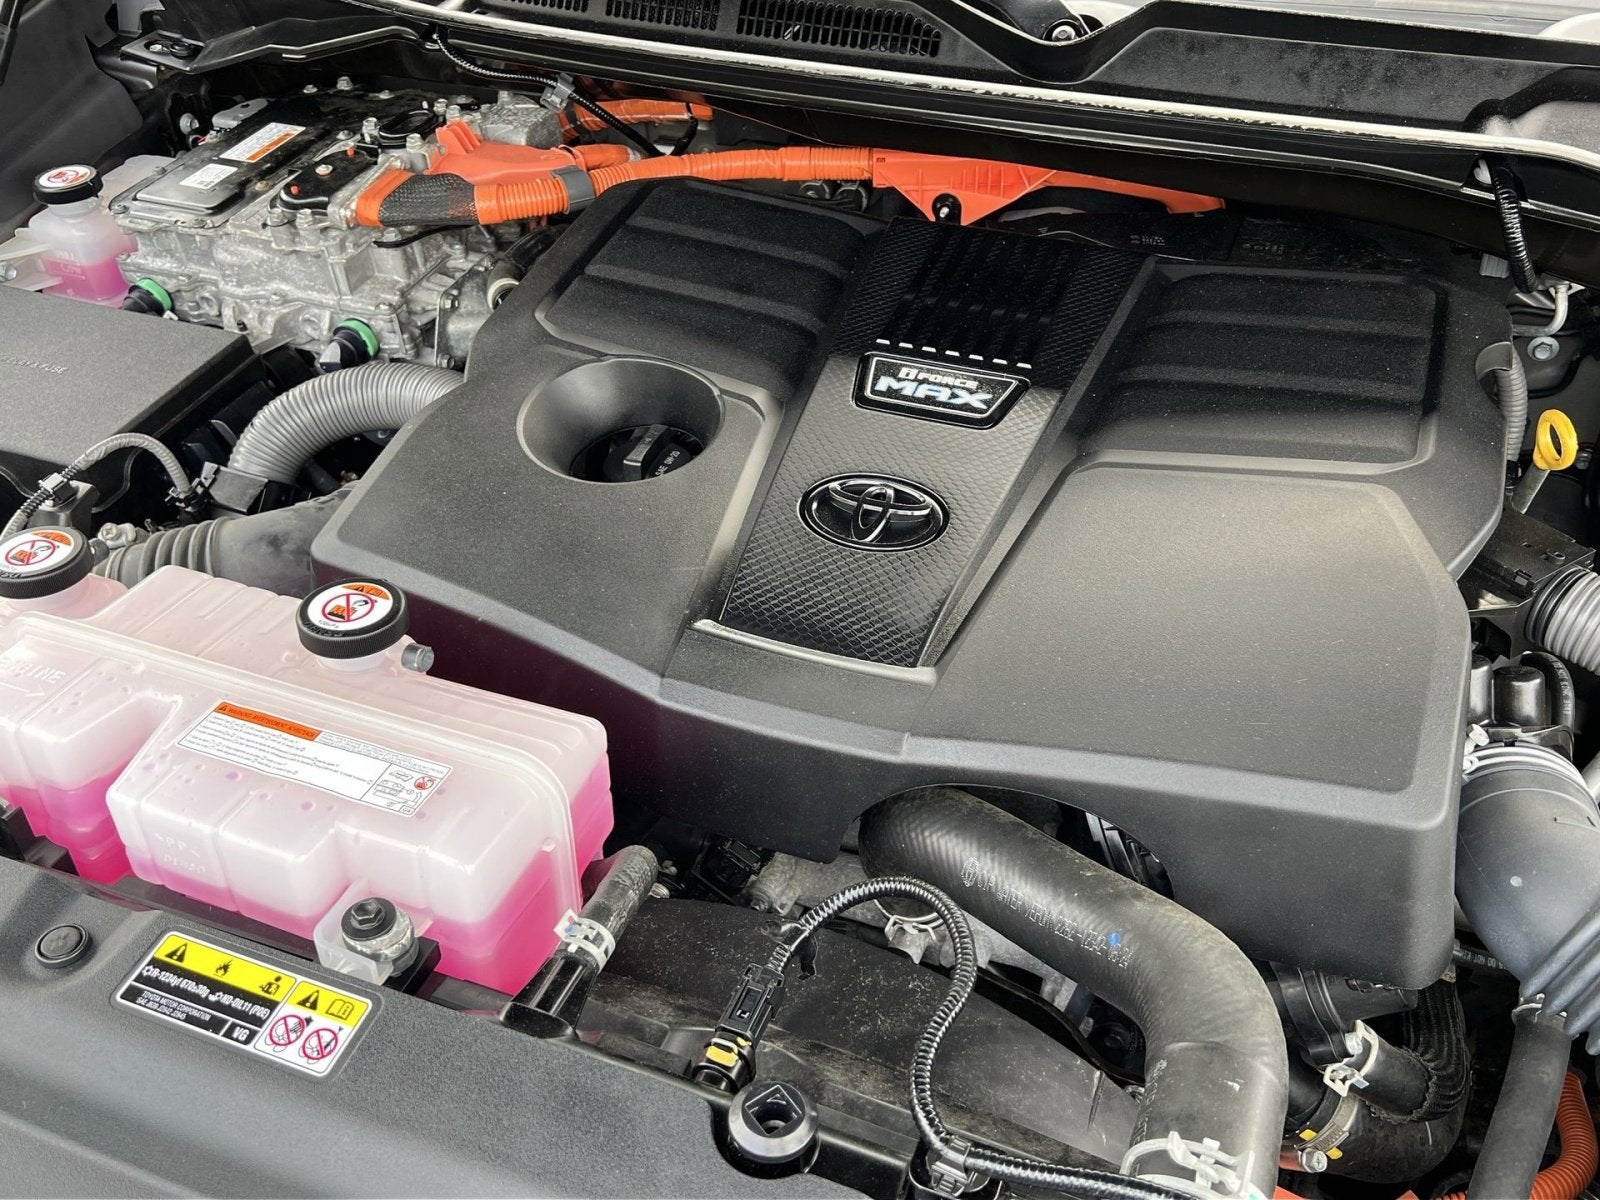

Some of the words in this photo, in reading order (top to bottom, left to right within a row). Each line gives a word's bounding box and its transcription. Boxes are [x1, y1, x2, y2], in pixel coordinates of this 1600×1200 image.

[874, 375, 993, 410] MAX
[141, 990, 161, 1003] TOYOTA
[160, 996, 179, 1009] MOTOR
[177, 1001, 212, 1021] CORPORATION
[248, 1006, 271, 1021] (POE)
[231, 1026, 250, 1041] VG
